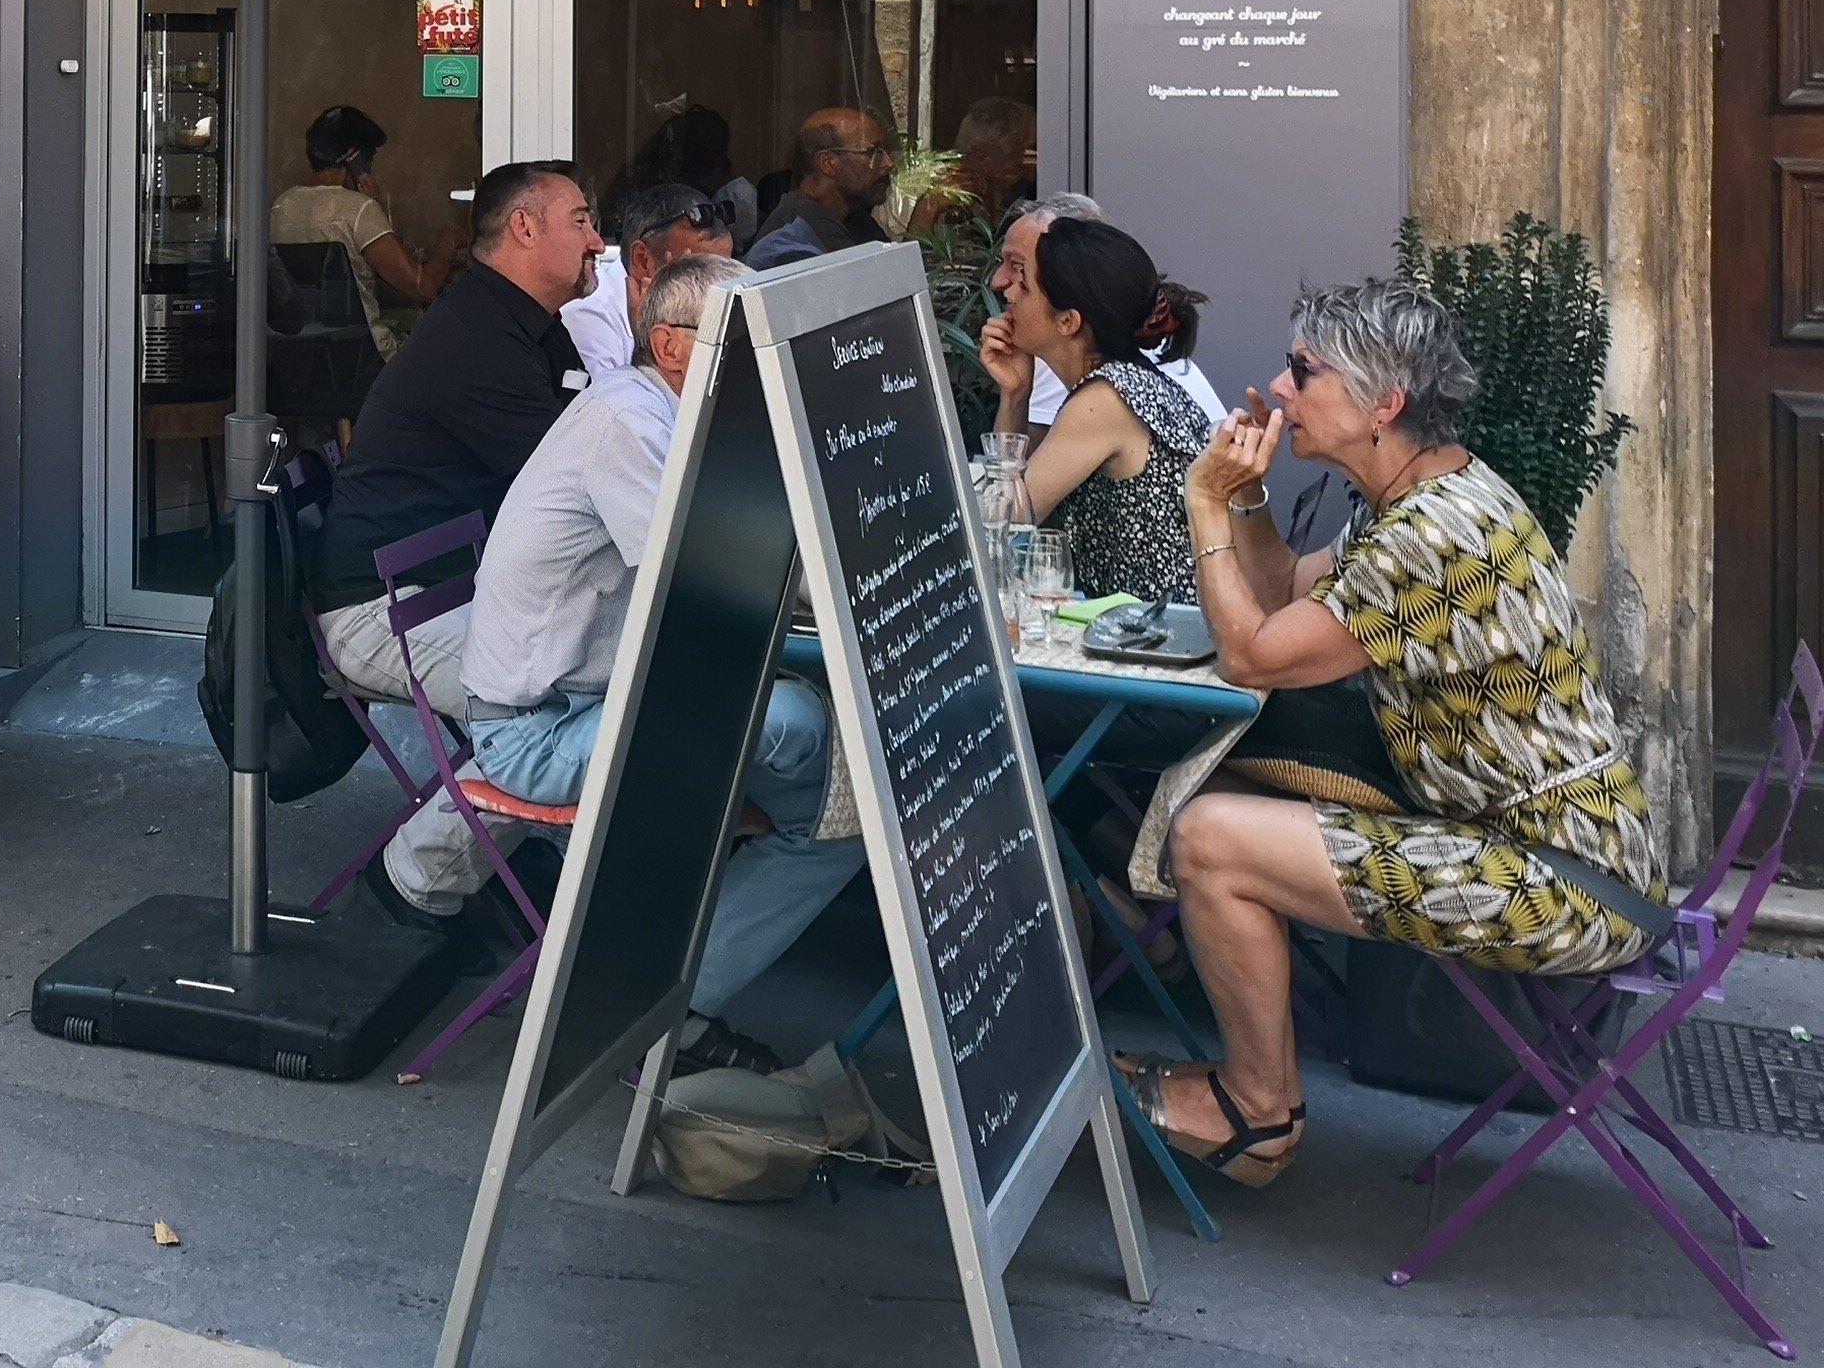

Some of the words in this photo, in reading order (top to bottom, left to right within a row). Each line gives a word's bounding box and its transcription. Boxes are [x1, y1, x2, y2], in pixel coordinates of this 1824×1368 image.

[1163, 6, 1235, 27] changeant
[1237, 5, 1288, 26] chaque
[1287, 6, 1322, 26] jour
[1178, 36, 1200, 46] au
[1201, 33, 1226, 52] gré
[1229, 30, 1250, 46] du
[1253, 30, 1306, 46] marché
